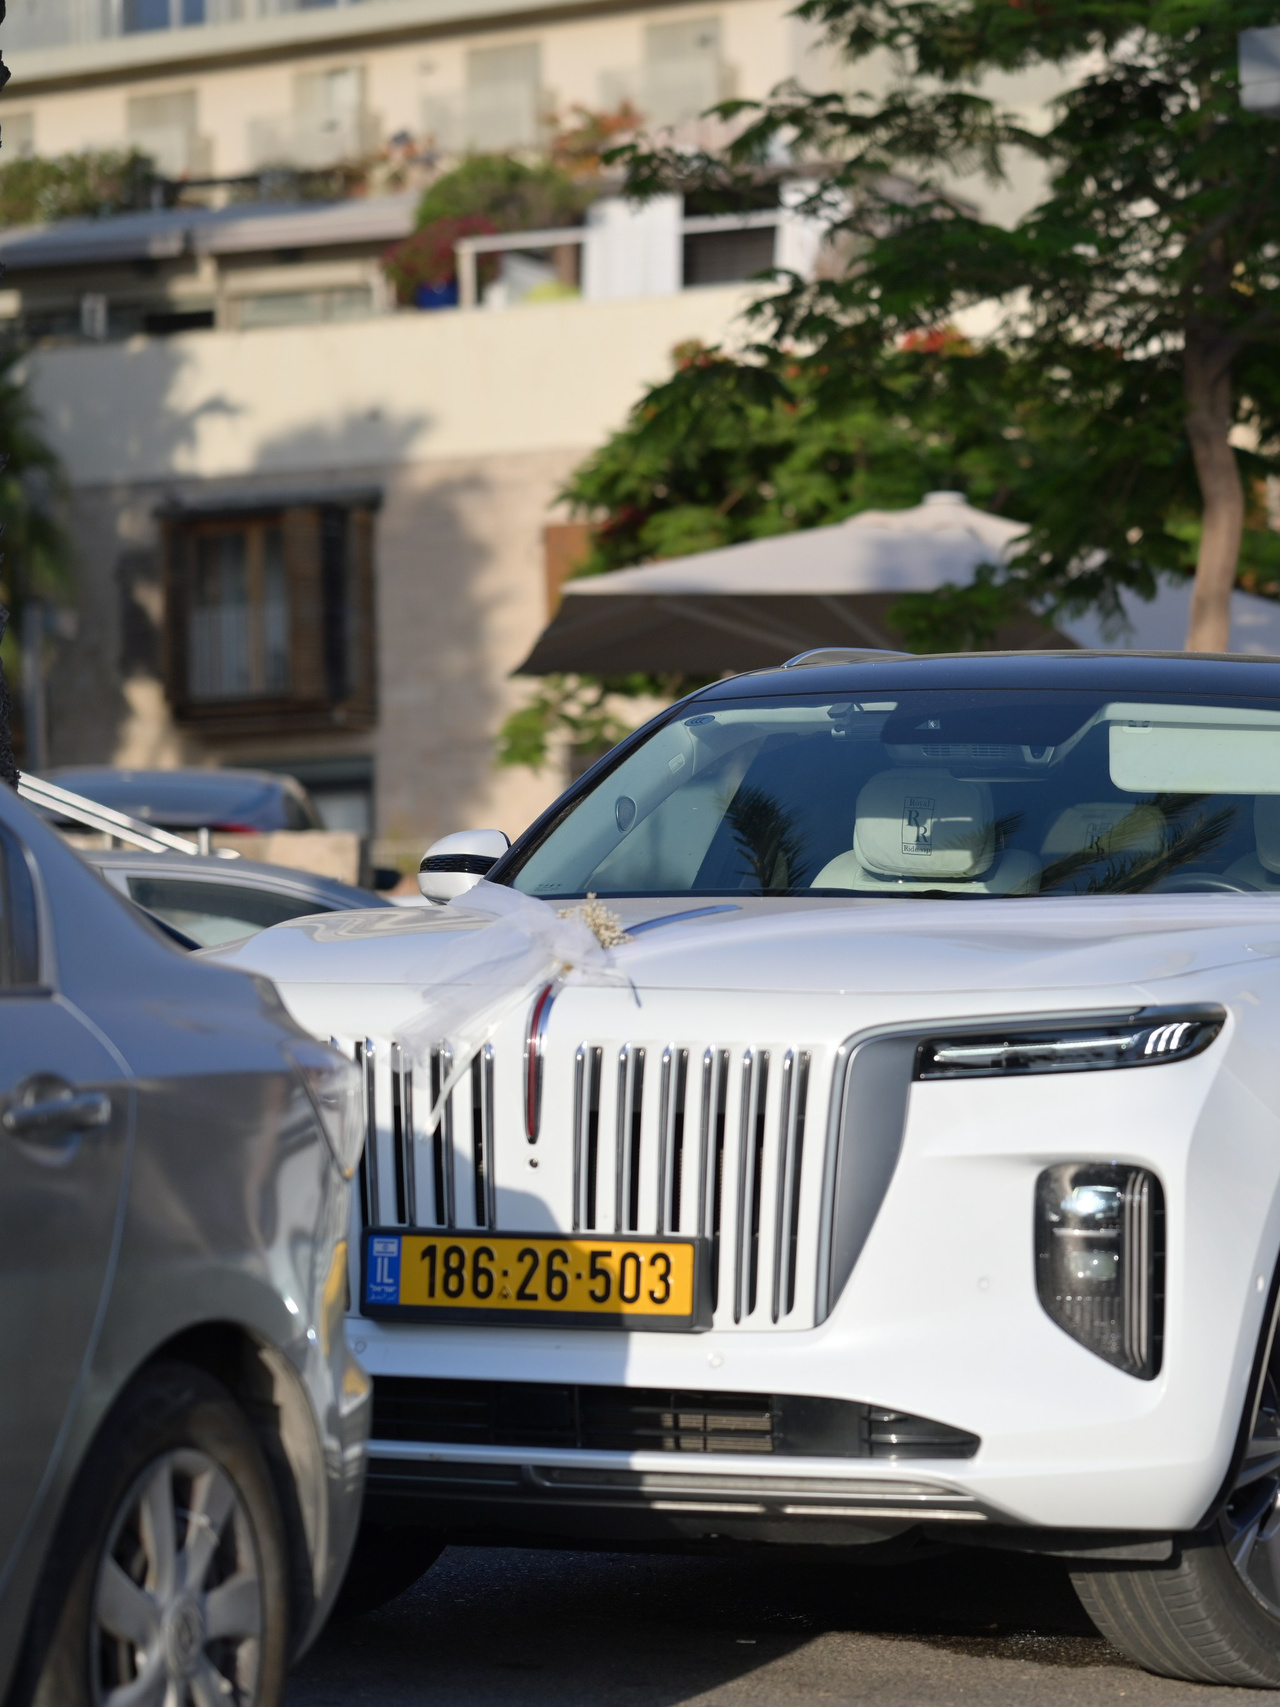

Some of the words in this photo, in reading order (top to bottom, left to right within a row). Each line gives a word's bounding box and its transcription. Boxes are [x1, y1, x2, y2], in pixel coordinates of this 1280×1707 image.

[909, 799, 931, 808] Royal
[906, 810, 920, 827] R
[915, 825, 929, 843] R
[376, 1257, 395, 1284] IL
